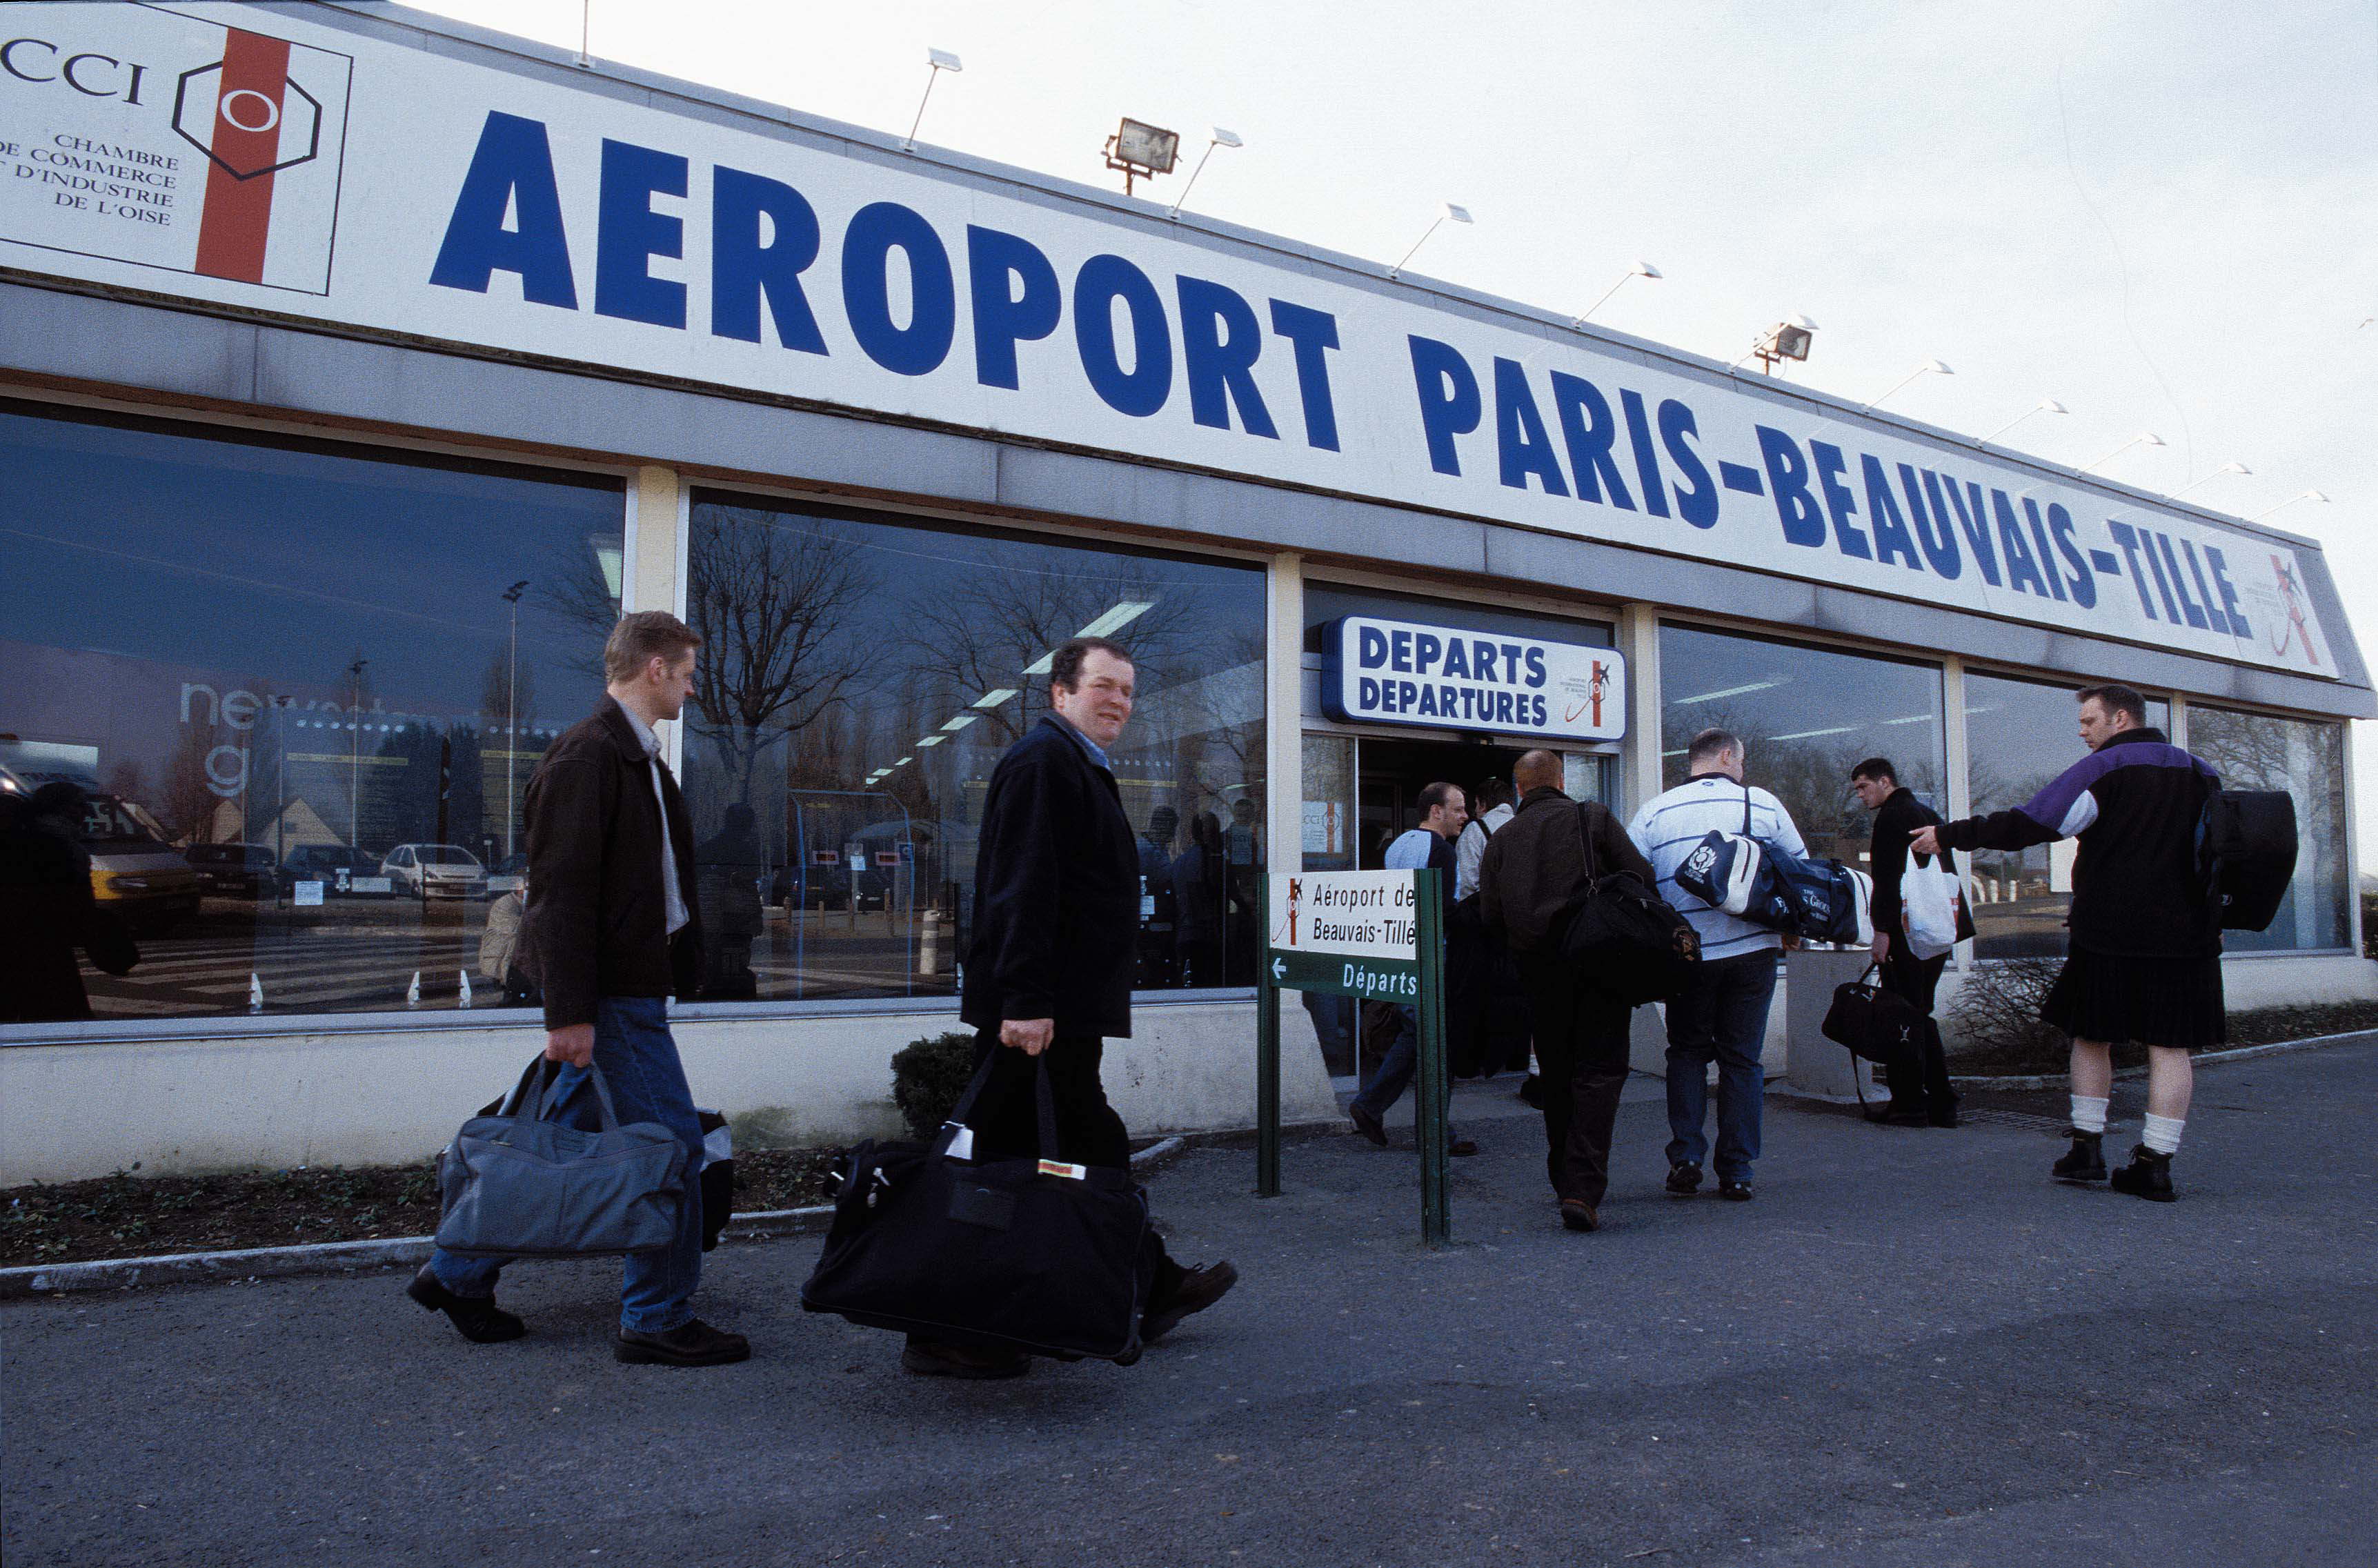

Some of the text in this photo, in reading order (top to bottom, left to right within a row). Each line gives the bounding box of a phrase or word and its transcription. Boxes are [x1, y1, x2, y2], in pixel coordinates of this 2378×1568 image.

[0, 38, 149, 106] CCI
[30, 148, 177, 190] COMMERCE
[55, 134, 179, 171] CHAMBRE
[14, 163, 174, 208] D'INDUSTRIE
[55, 192, 171, 226] DE L'OISE
[428, 110, 1341, 453] AEROPORT
[1359, 625, 1547, 688] DEPARTS
[1359, 676, 1547, 727] DEPARTURES
[1313, 882, 1416, 913] Aéroport de
[1314, 917, 1416, 945] Beauvais-Tillé
[1342, 963, 1417, 997] Départs
